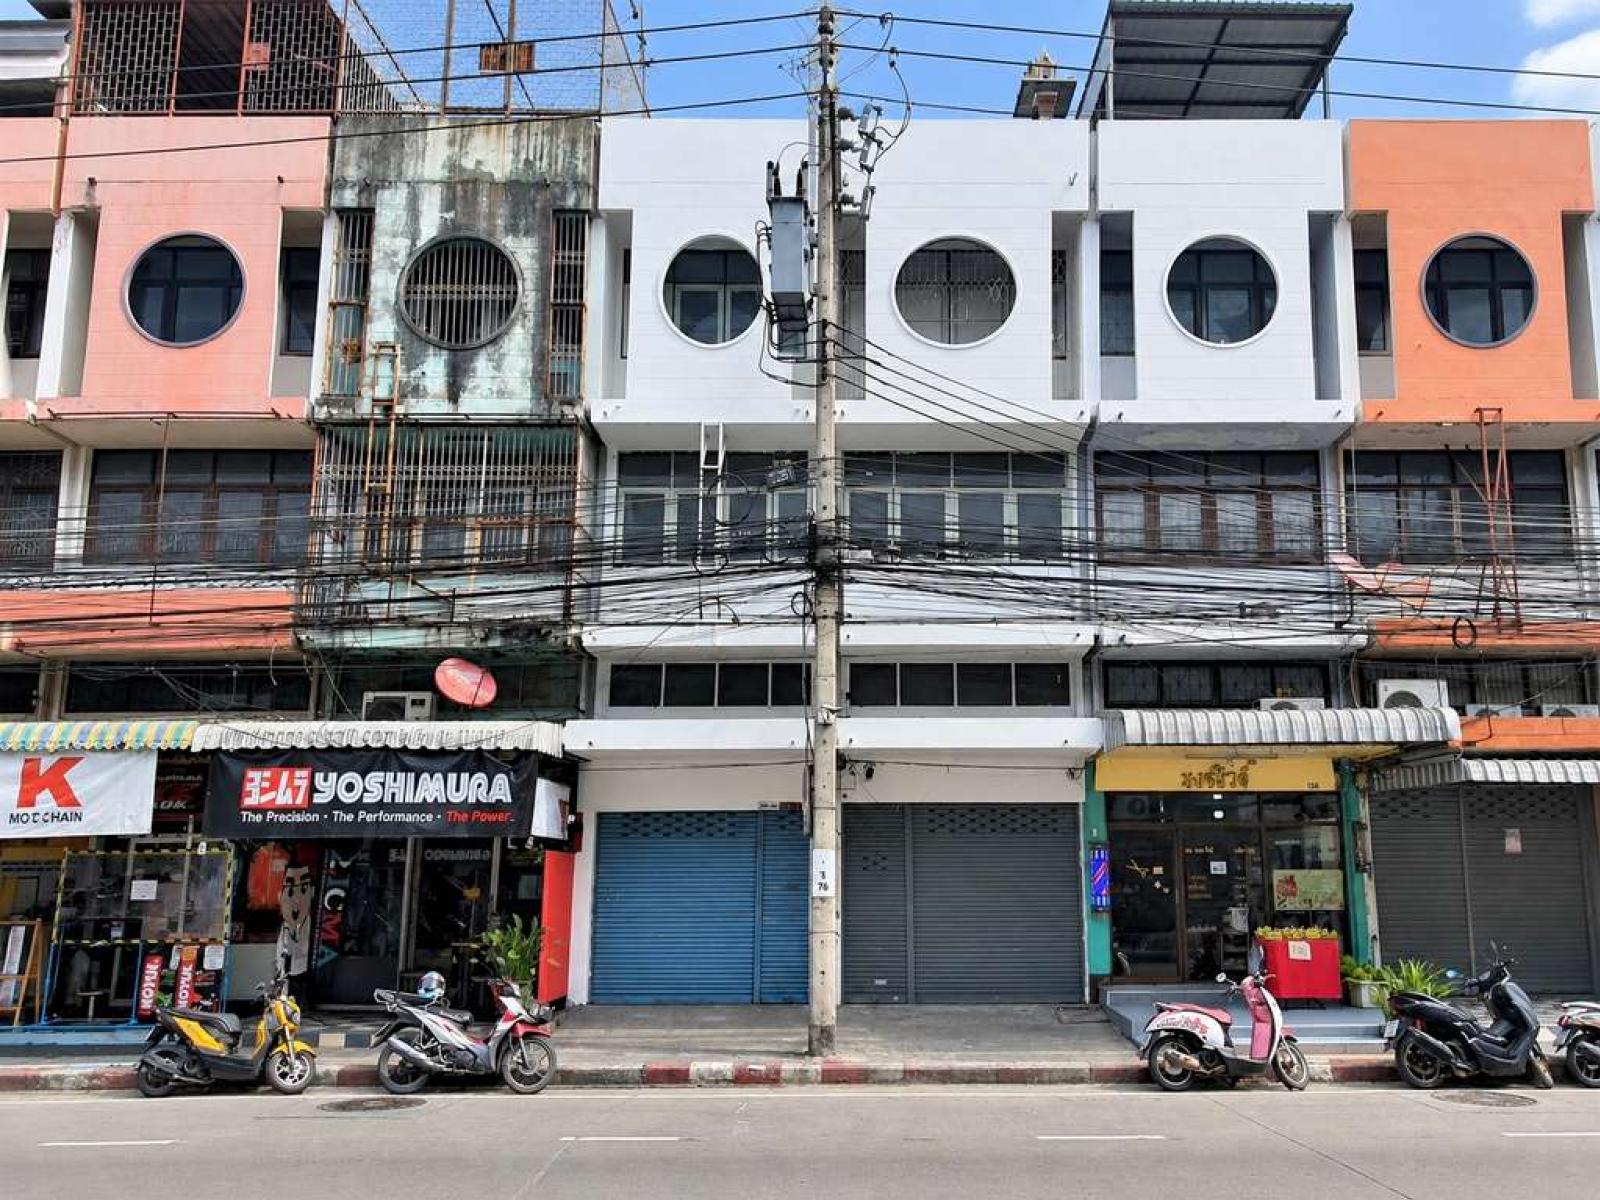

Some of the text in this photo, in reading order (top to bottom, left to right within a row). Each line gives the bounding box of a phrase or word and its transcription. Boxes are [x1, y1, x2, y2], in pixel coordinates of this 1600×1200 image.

[17, 757, 84, 808] K
[312, 772, 512, 803] YOSHIMURA
[240, 811, 262, 823] The
[266, 811, 320, 823] Precision
[332, 811, 354, 823] The
[357, 811, 434, 823] Performance
[446, 811, 468, 822] The
